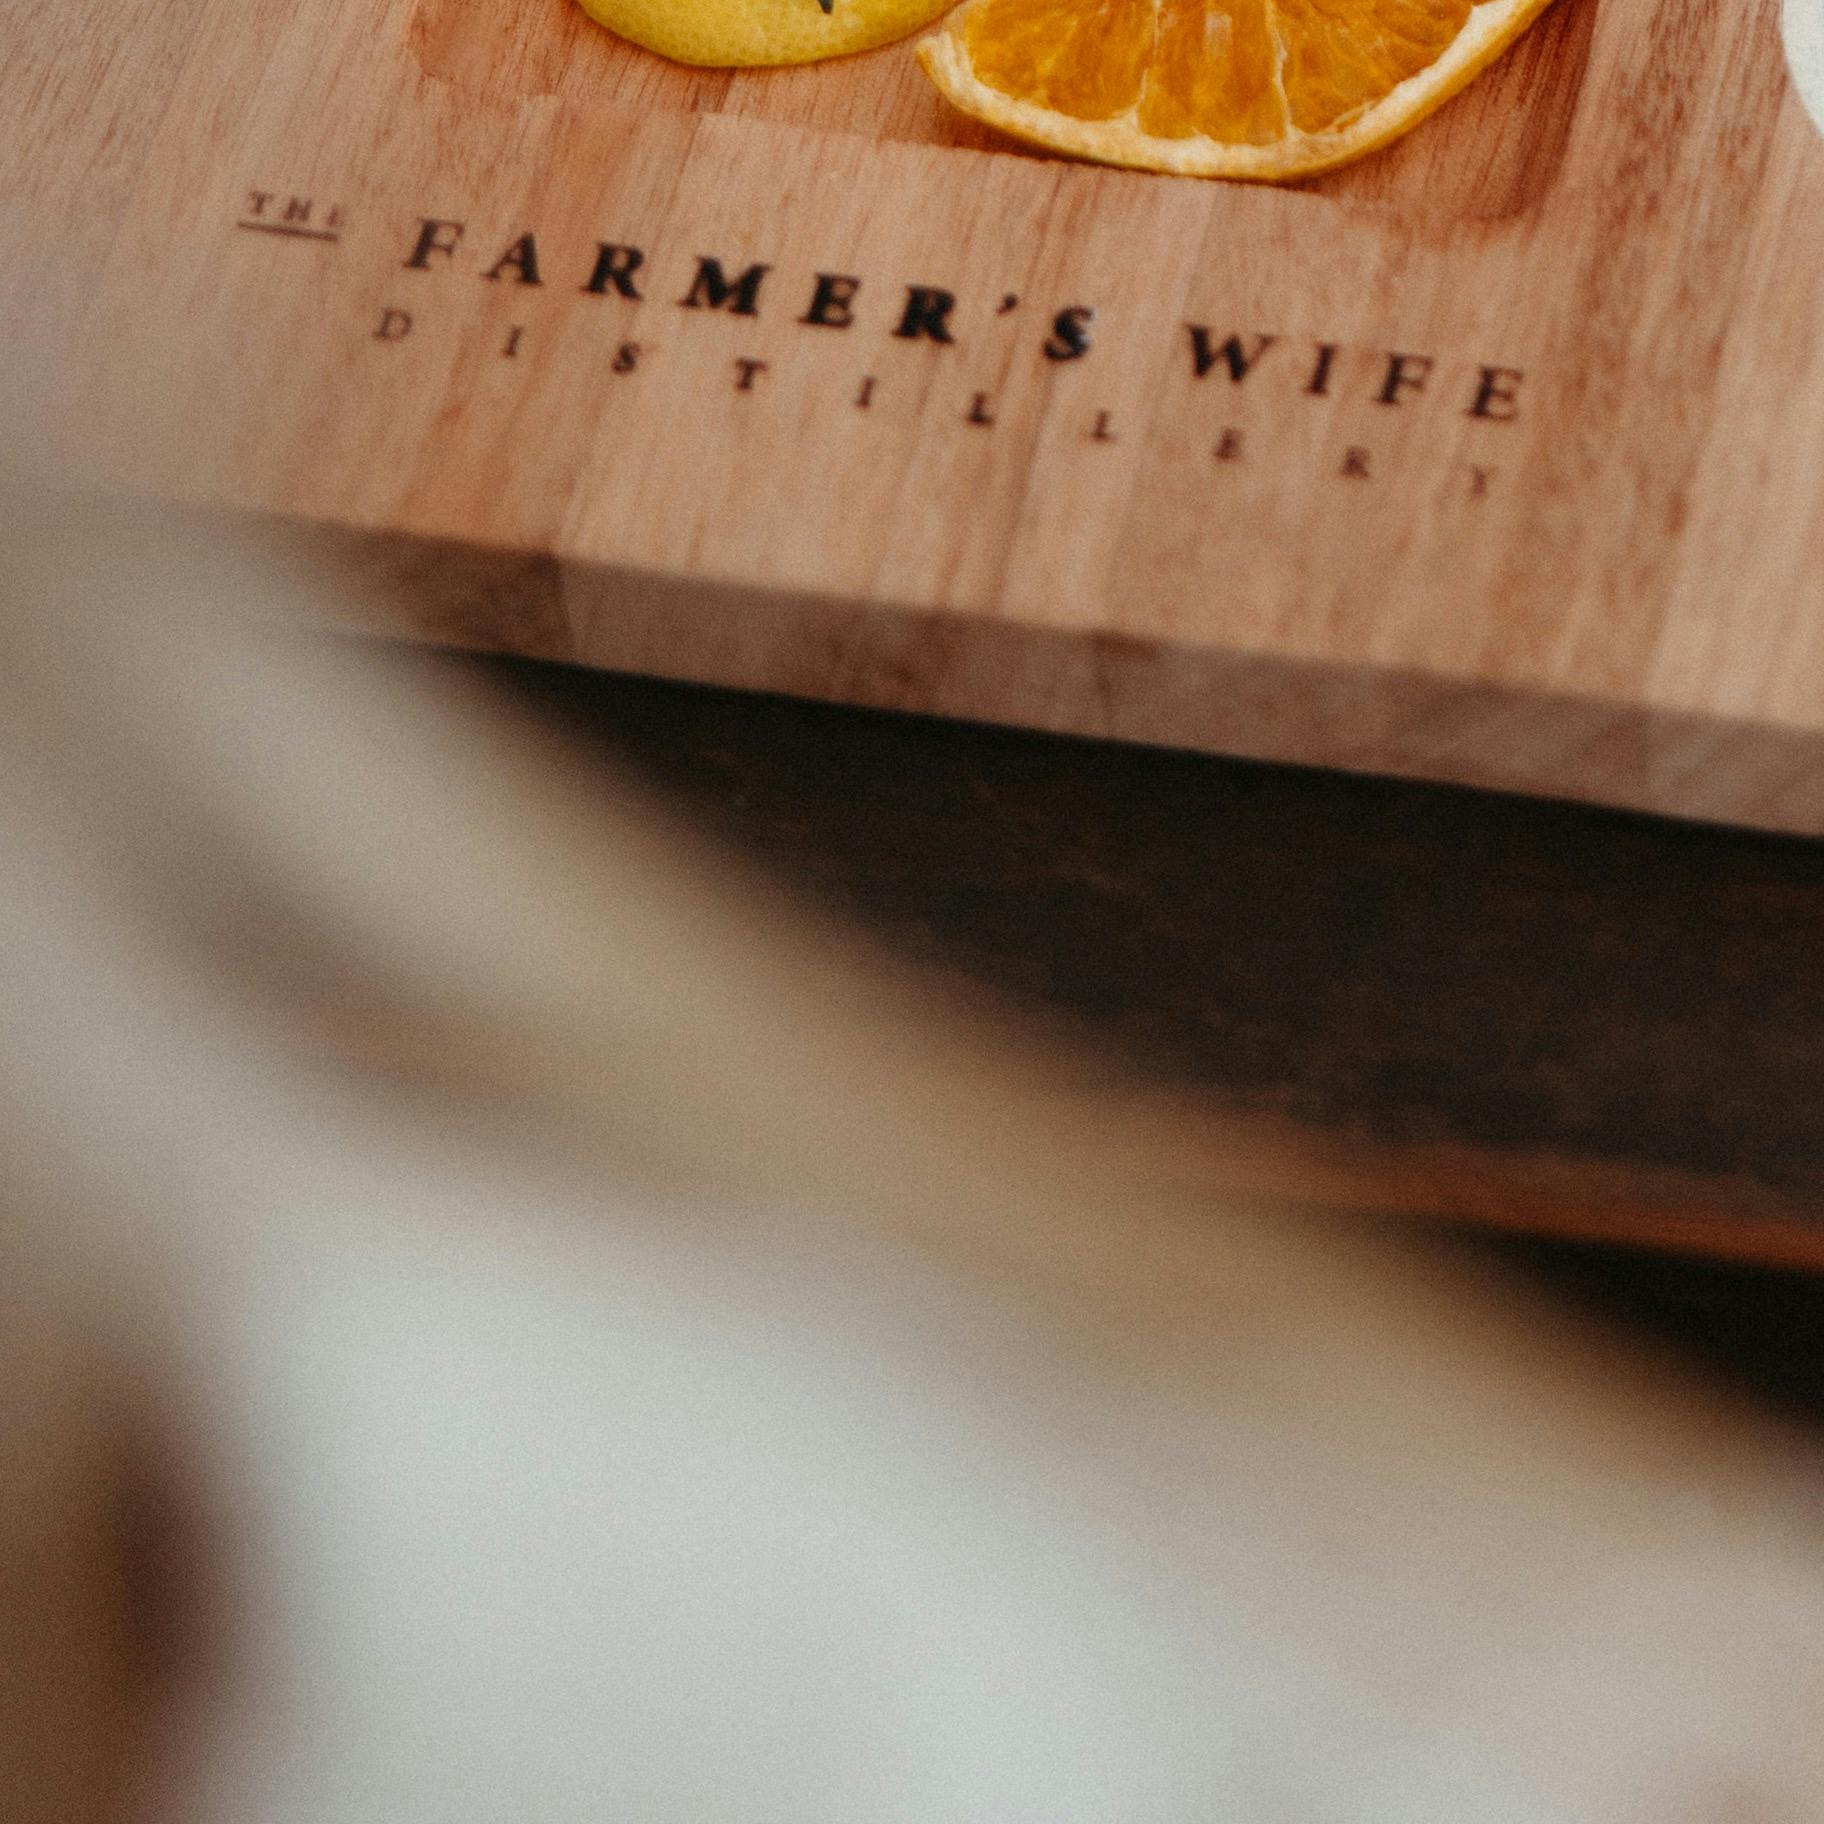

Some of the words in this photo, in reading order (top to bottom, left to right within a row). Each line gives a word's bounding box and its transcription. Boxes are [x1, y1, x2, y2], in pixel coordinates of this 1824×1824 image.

[247, 190, 348, 228] THE
[402, 216, 1095, 364] FARMER'S
[1184, 321, 1527, 425] WIFE
[370, 307, 1496, 503] DISTILLERY
